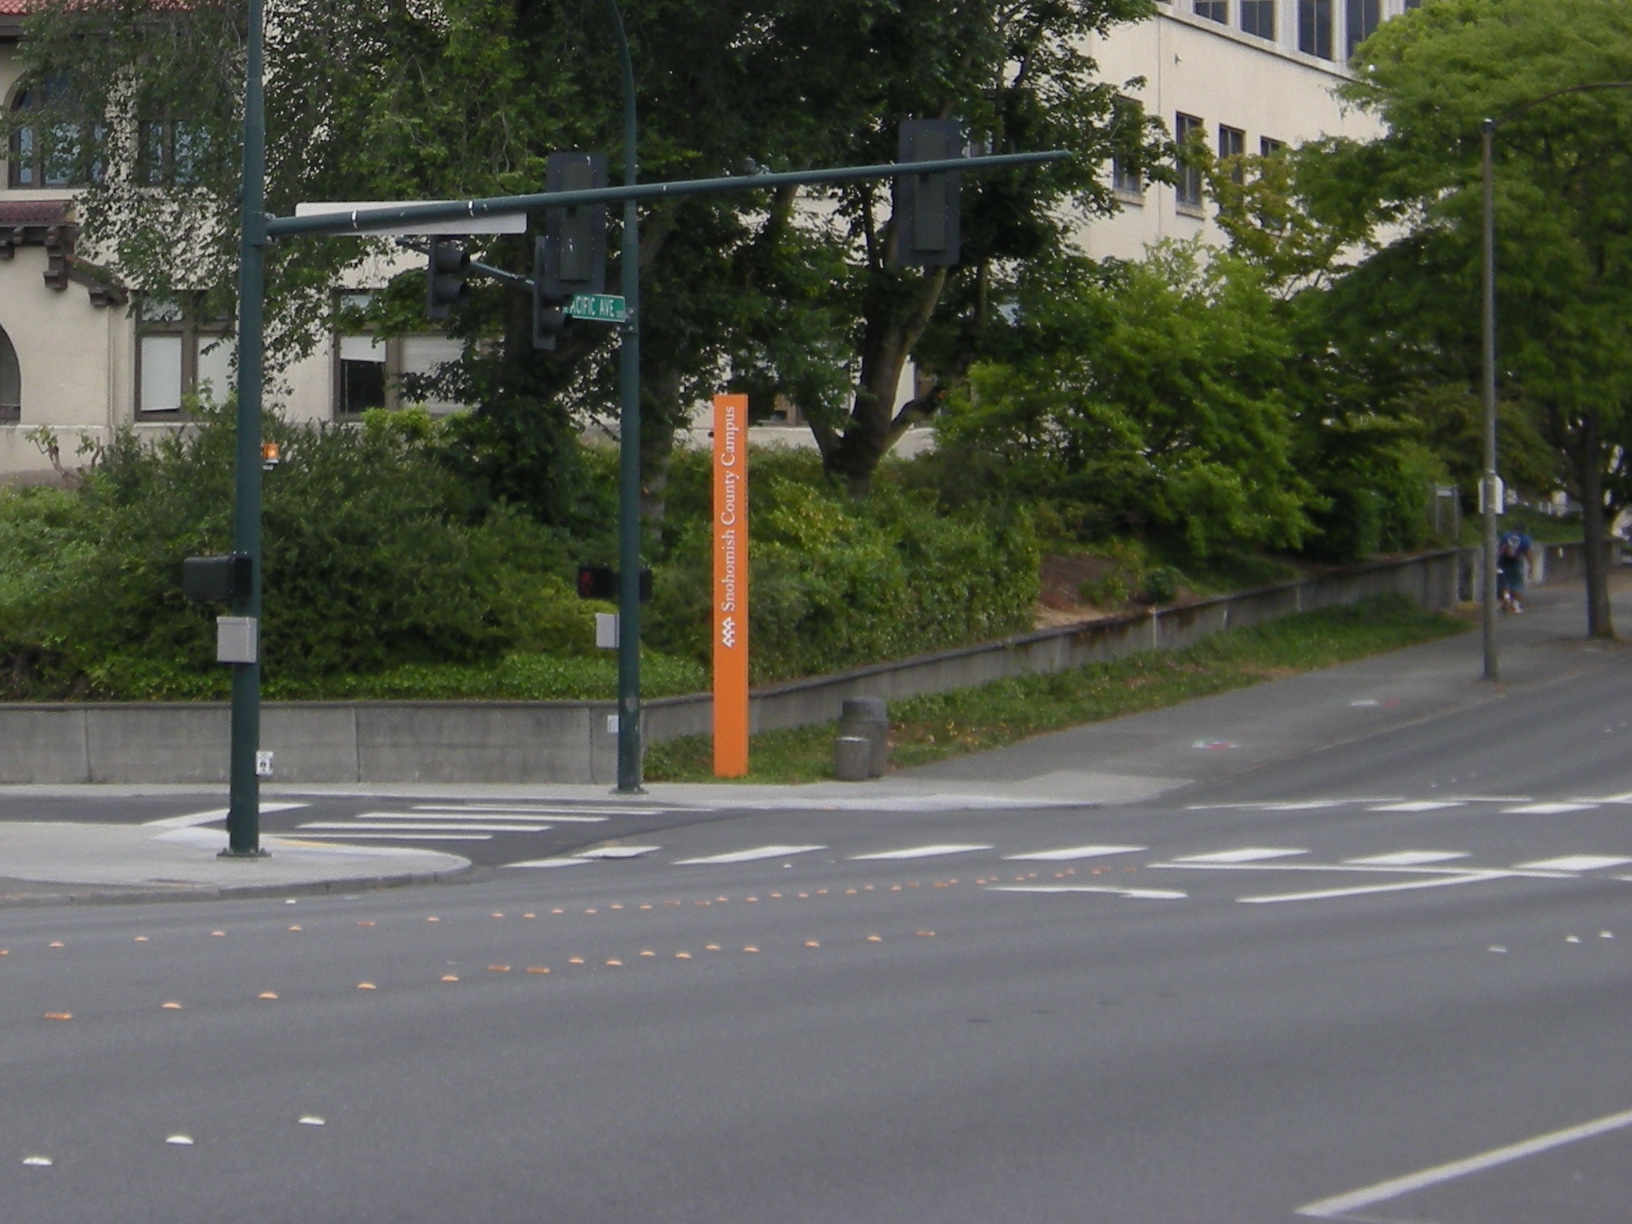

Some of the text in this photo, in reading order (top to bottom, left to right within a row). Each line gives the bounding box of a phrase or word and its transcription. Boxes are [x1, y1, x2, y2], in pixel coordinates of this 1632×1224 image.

[563, 296, 596, 316] ACIFIC
[599, 299, 615, 317] AVE
[720, 406, 740, 612] Snohomish County Campus
